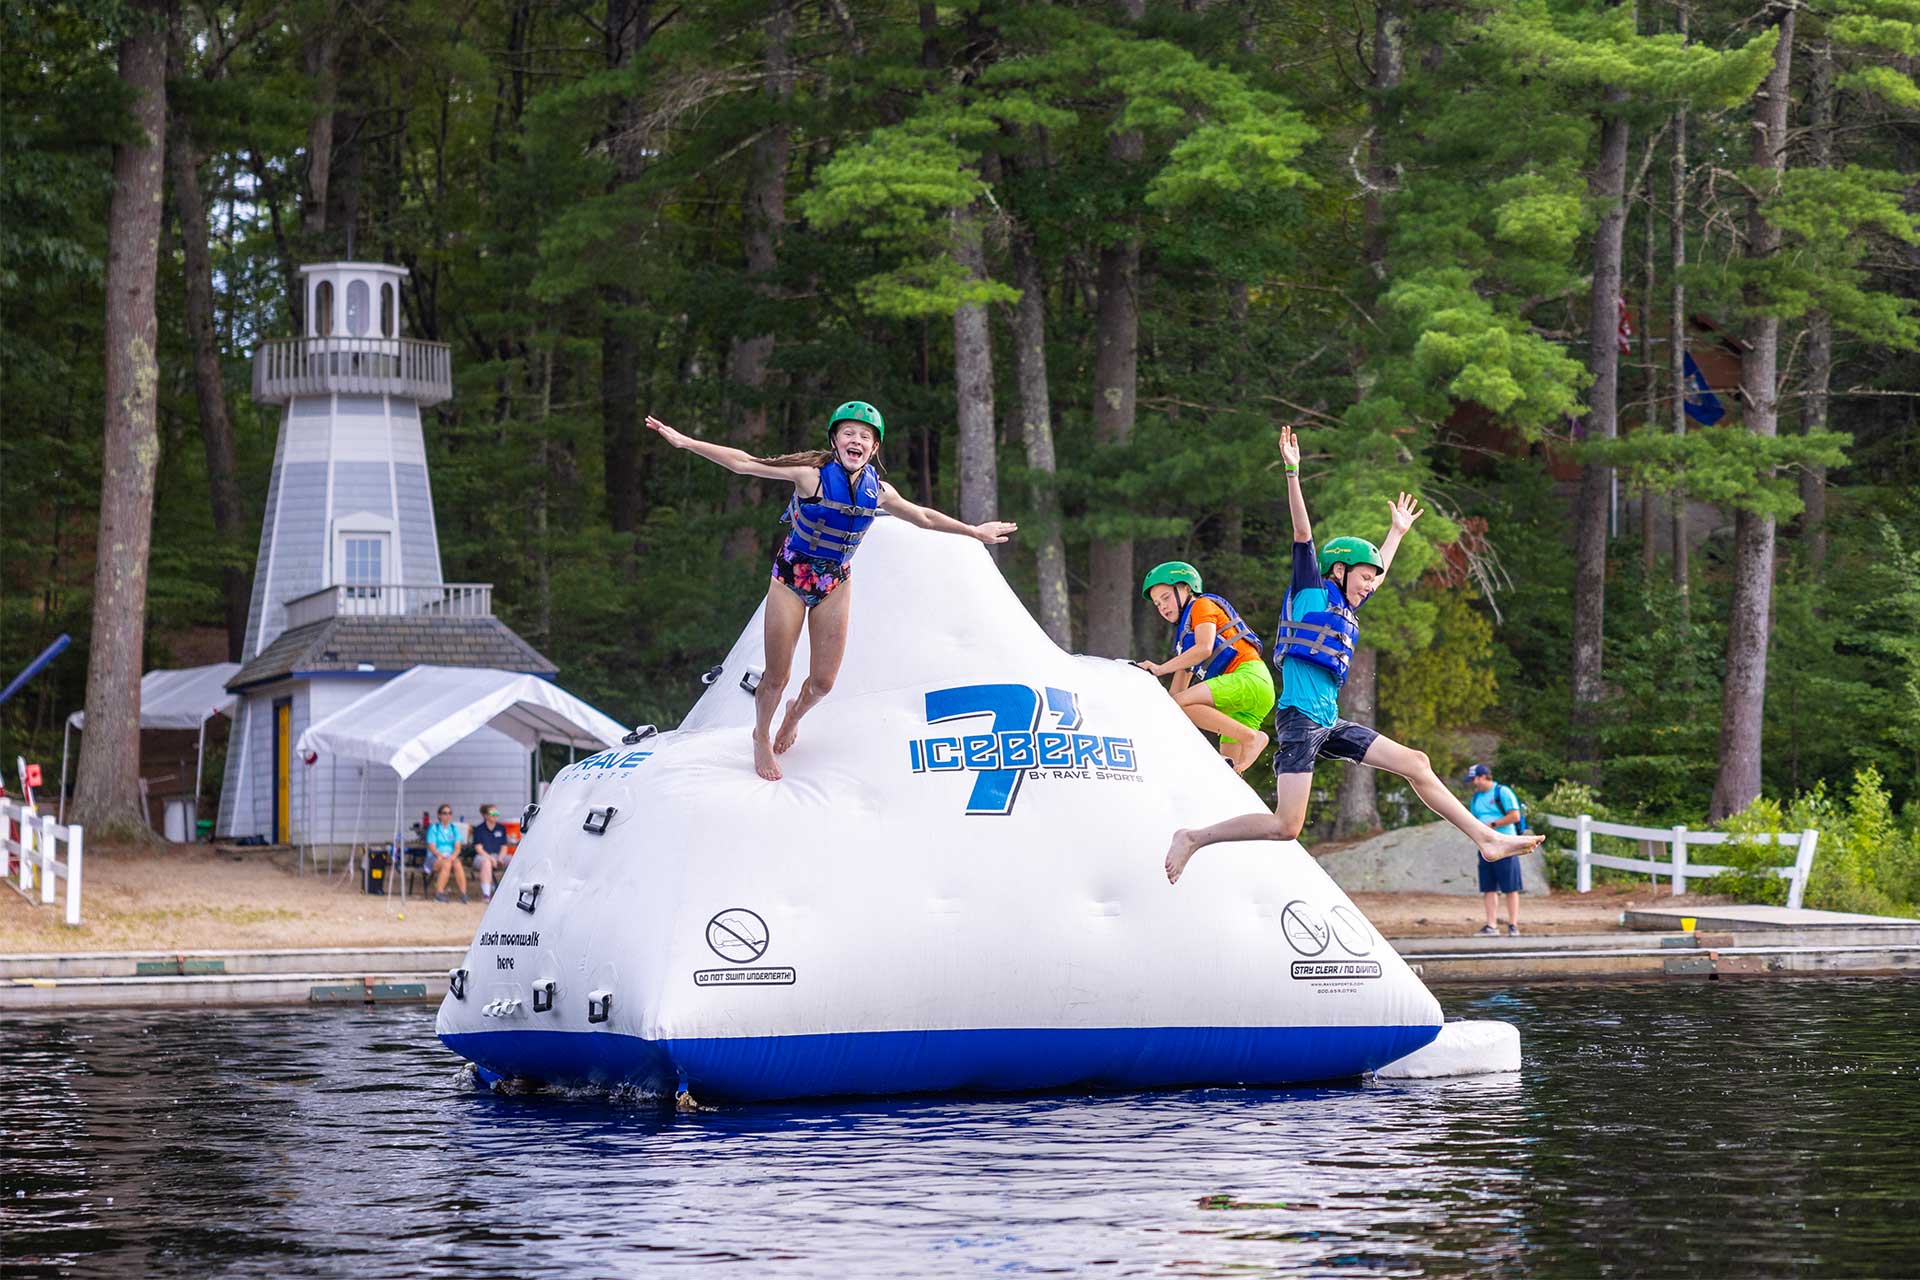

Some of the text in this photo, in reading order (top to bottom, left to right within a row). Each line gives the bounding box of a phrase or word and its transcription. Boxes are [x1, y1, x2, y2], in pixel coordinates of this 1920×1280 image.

[572, 752, 654, 771] RAVE
[562, 771, 631, 781] SPORTS
[1053, 771, 1091, 779] RAVE
[499, 931, 540, 946] moonwalk
[497, 954, 514, 970] here
[1294, 965, 1314, 975] STAY
[1315, 965, 1338, 974] CLEAR
[1344, 965, 1354, 974] NO
[1355, 965, 1378, 974] DIVING
[710, 973, 723, 981] NOT
[725, 972, 745, 981] SWIM
